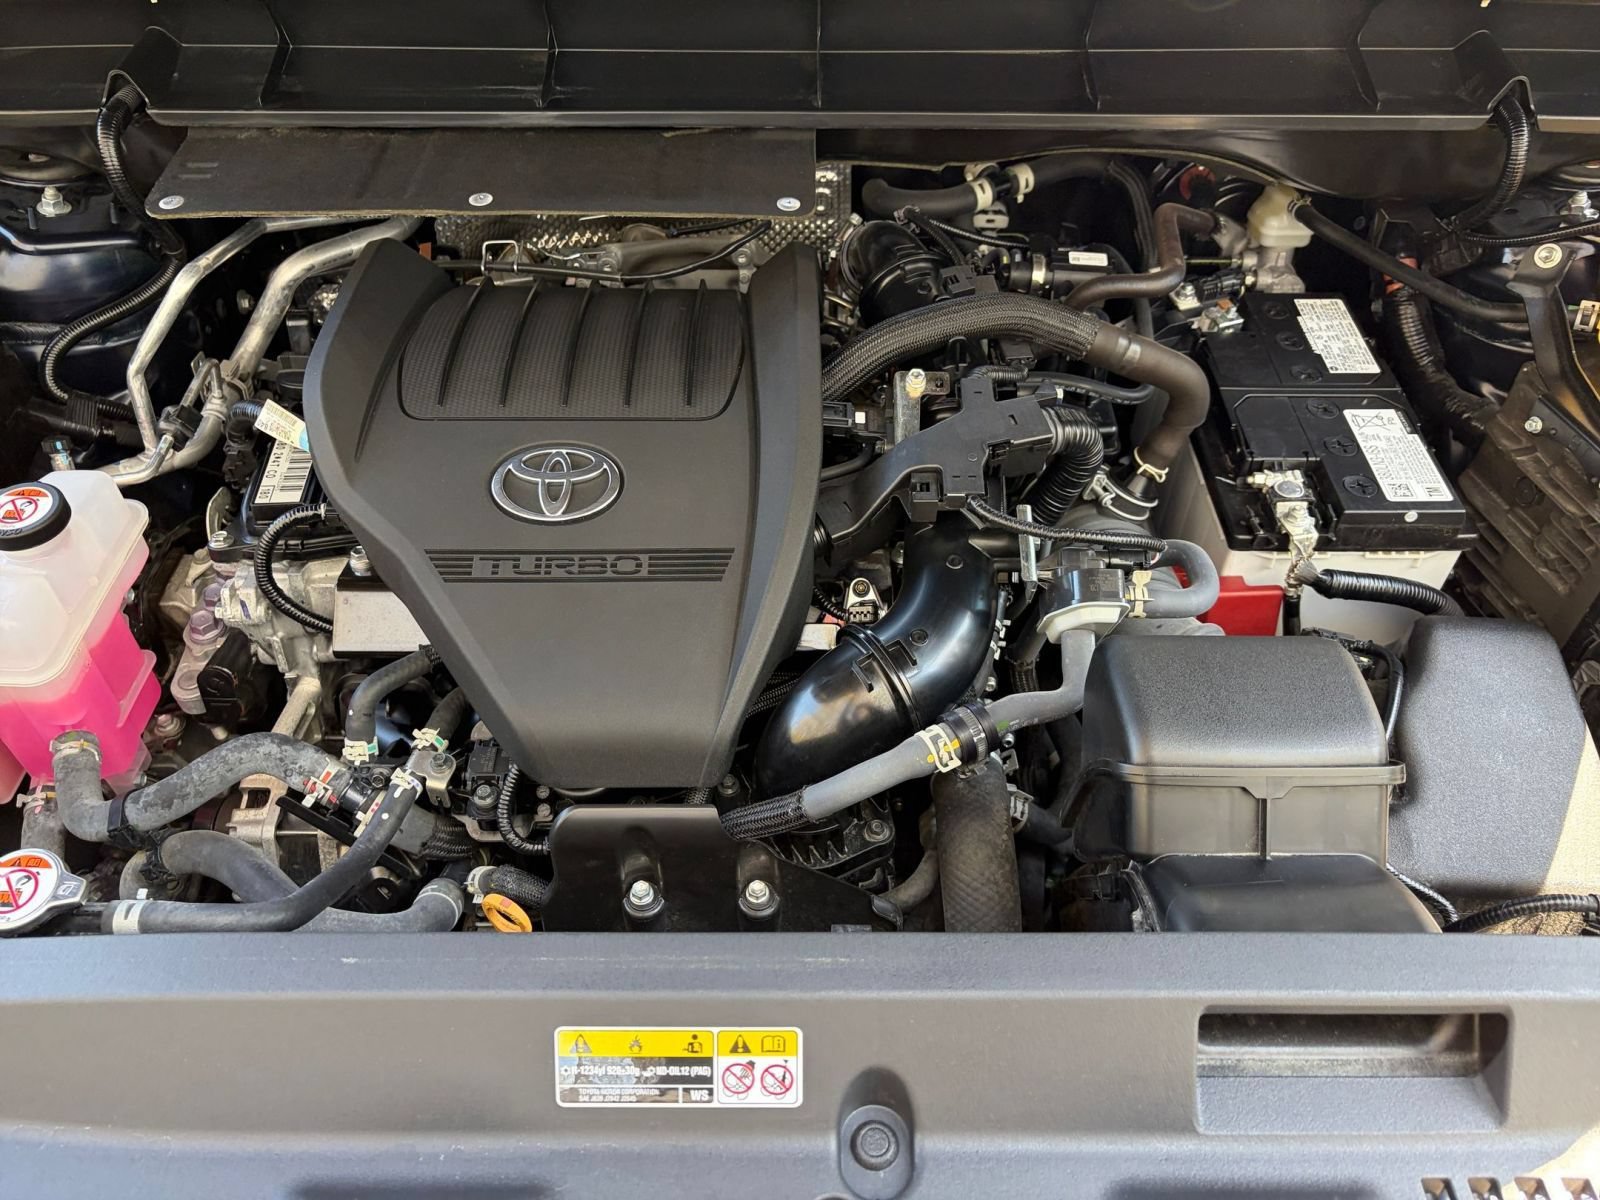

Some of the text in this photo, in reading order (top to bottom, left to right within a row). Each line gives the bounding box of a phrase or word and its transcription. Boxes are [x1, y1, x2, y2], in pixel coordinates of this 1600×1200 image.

[479, 555, 643, 575] TURBO
[690, 1066, 712, 1078] (PAG)
[690, 1089, 709, 1101] WS
